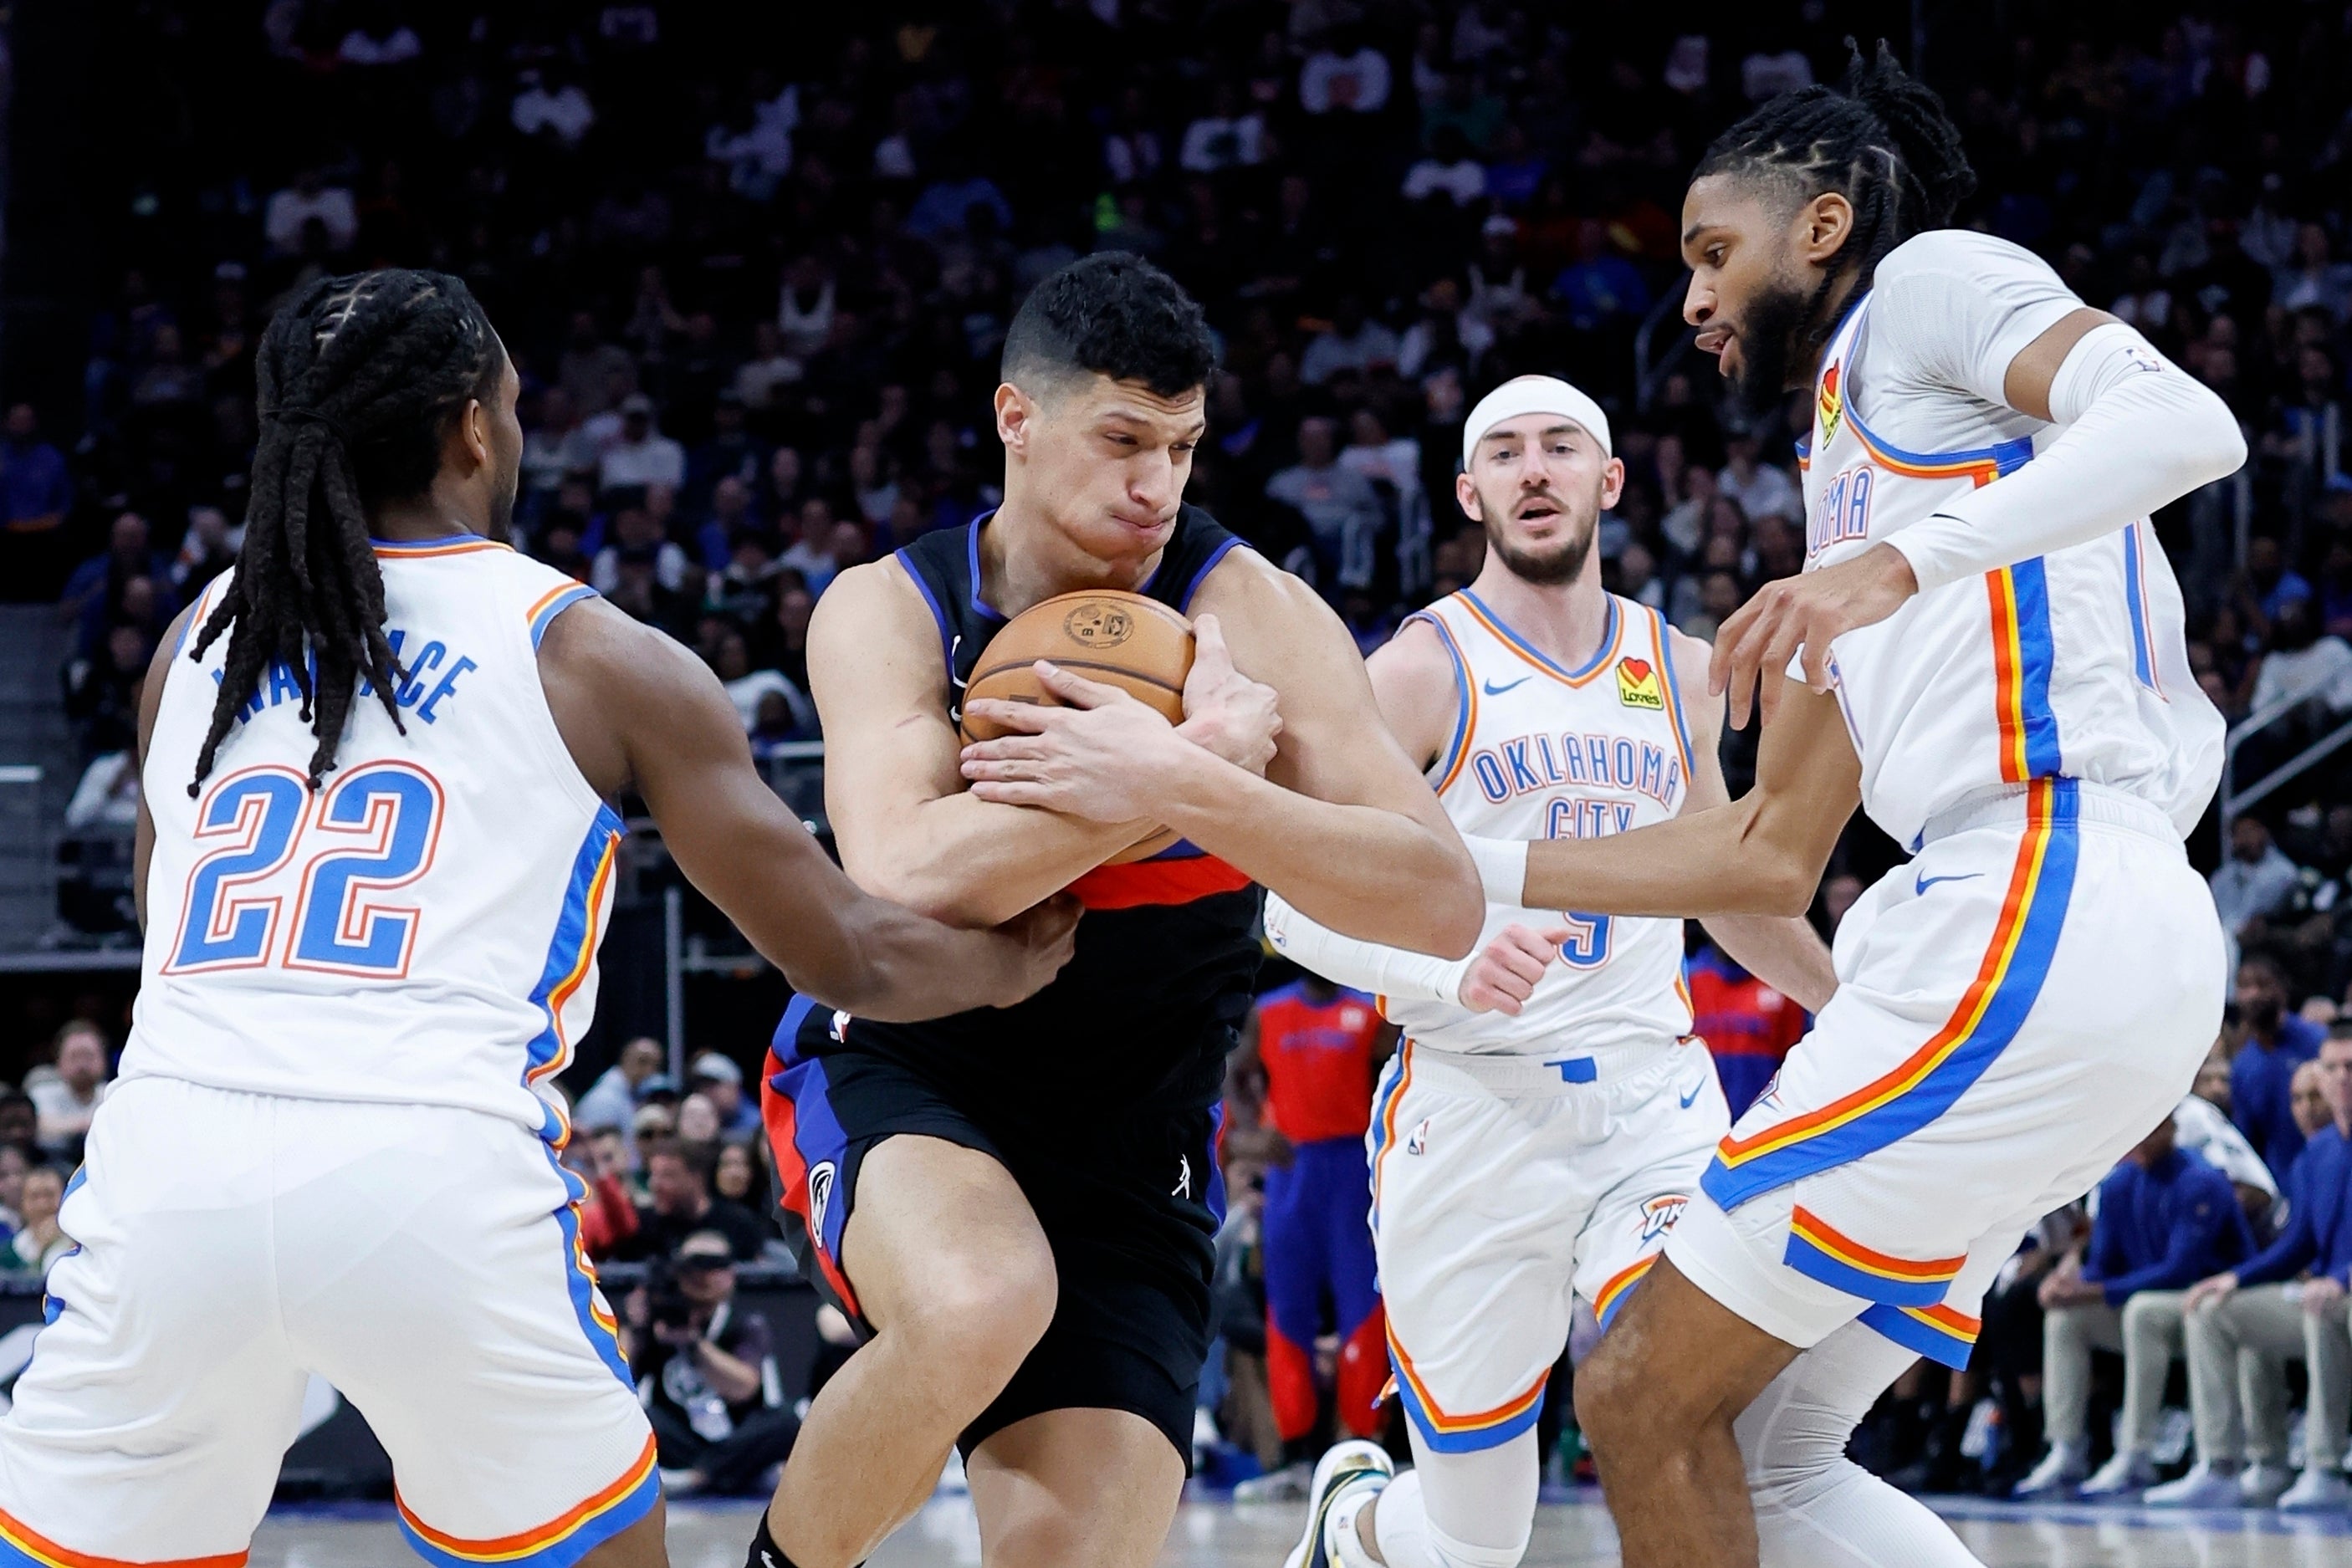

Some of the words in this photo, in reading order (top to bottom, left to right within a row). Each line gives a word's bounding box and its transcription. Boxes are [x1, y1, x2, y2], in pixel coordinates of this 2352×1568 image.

[1471, 731, 1680, 811] OKLAHOMA
[1544, 797, 1636, 840] CITY
[159, 758, 446, 979] 22
